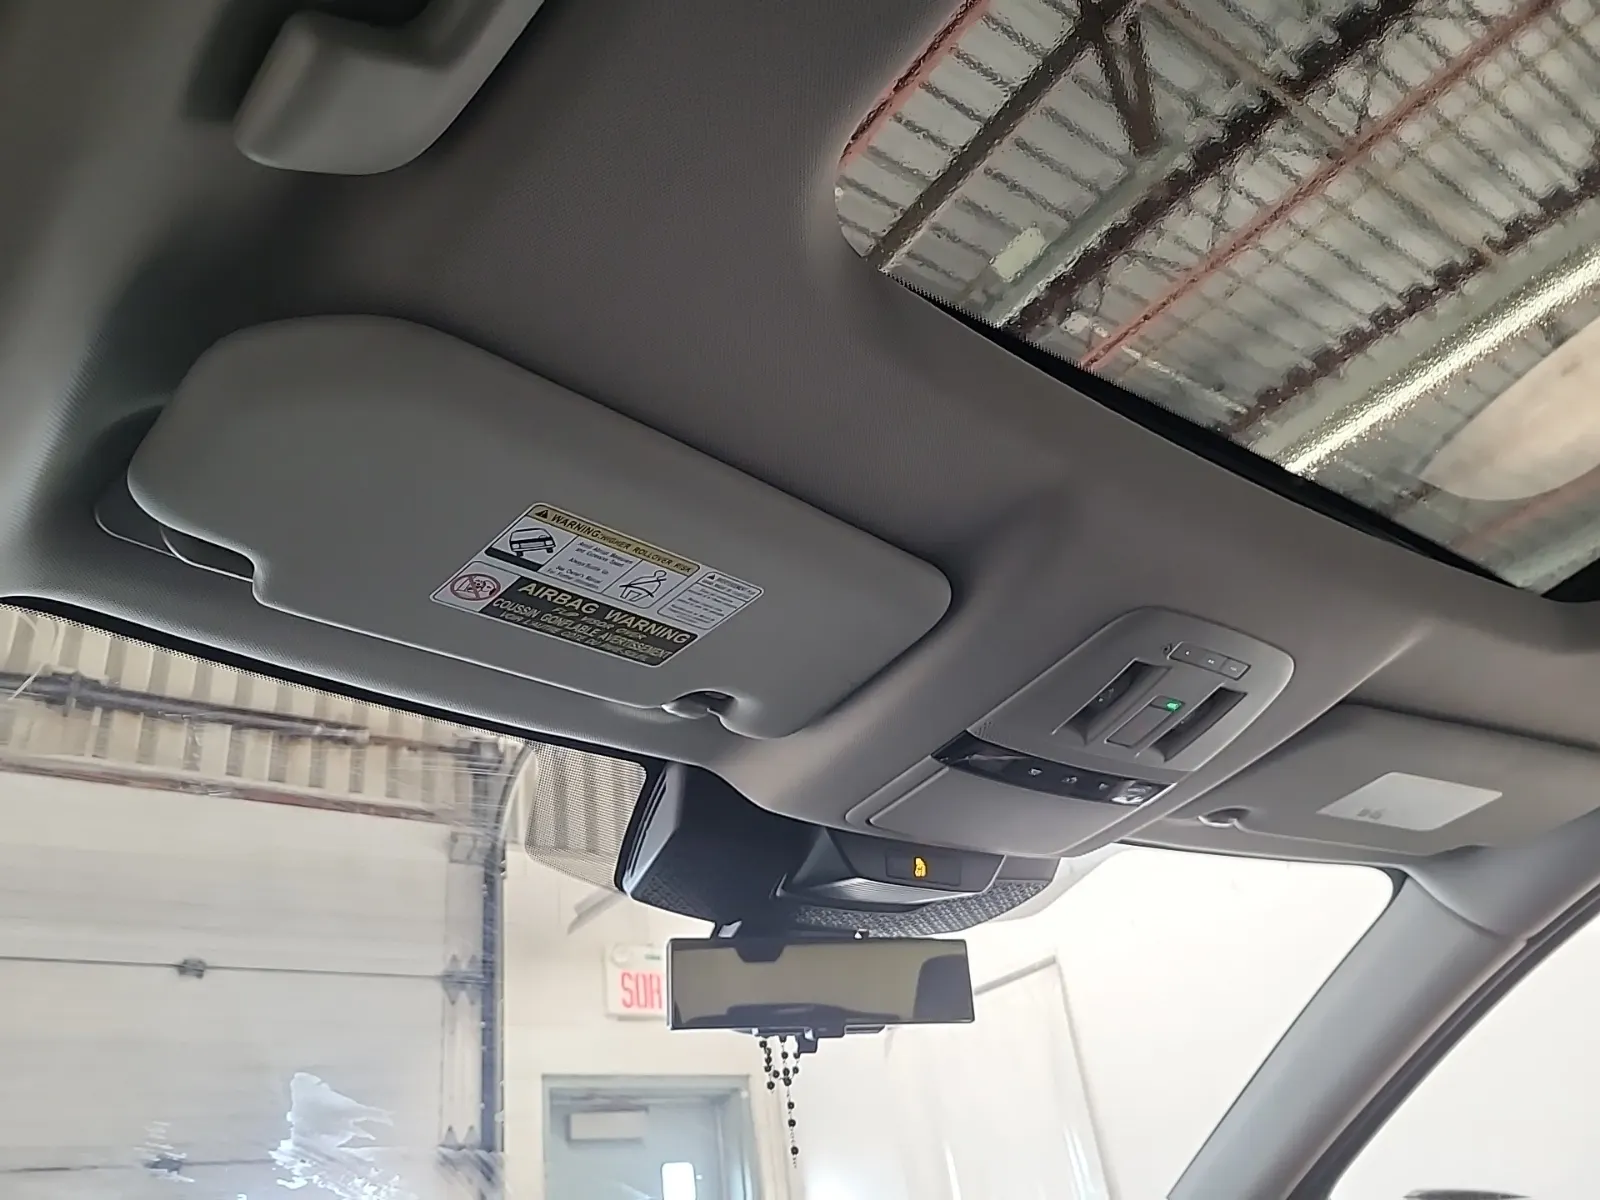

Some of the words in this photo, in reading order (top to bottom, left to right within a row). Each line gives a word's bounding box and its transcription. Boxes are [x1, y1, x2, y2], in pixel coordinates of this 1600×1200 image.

[632, 547, 674, 565] ROLLOVER
[674, 562, 693, 574] RISK
[493, 598, 541, 619] COUSSIN
[540, 613, 602, 638] GONFLABLE
[598, 632, 674, 659] AVERTISSEMENT
[518, 582, 600, 614] AIRBAG
[604, 609, 691, 644] WARNING
[621, 971, 663, 1009] SOR
